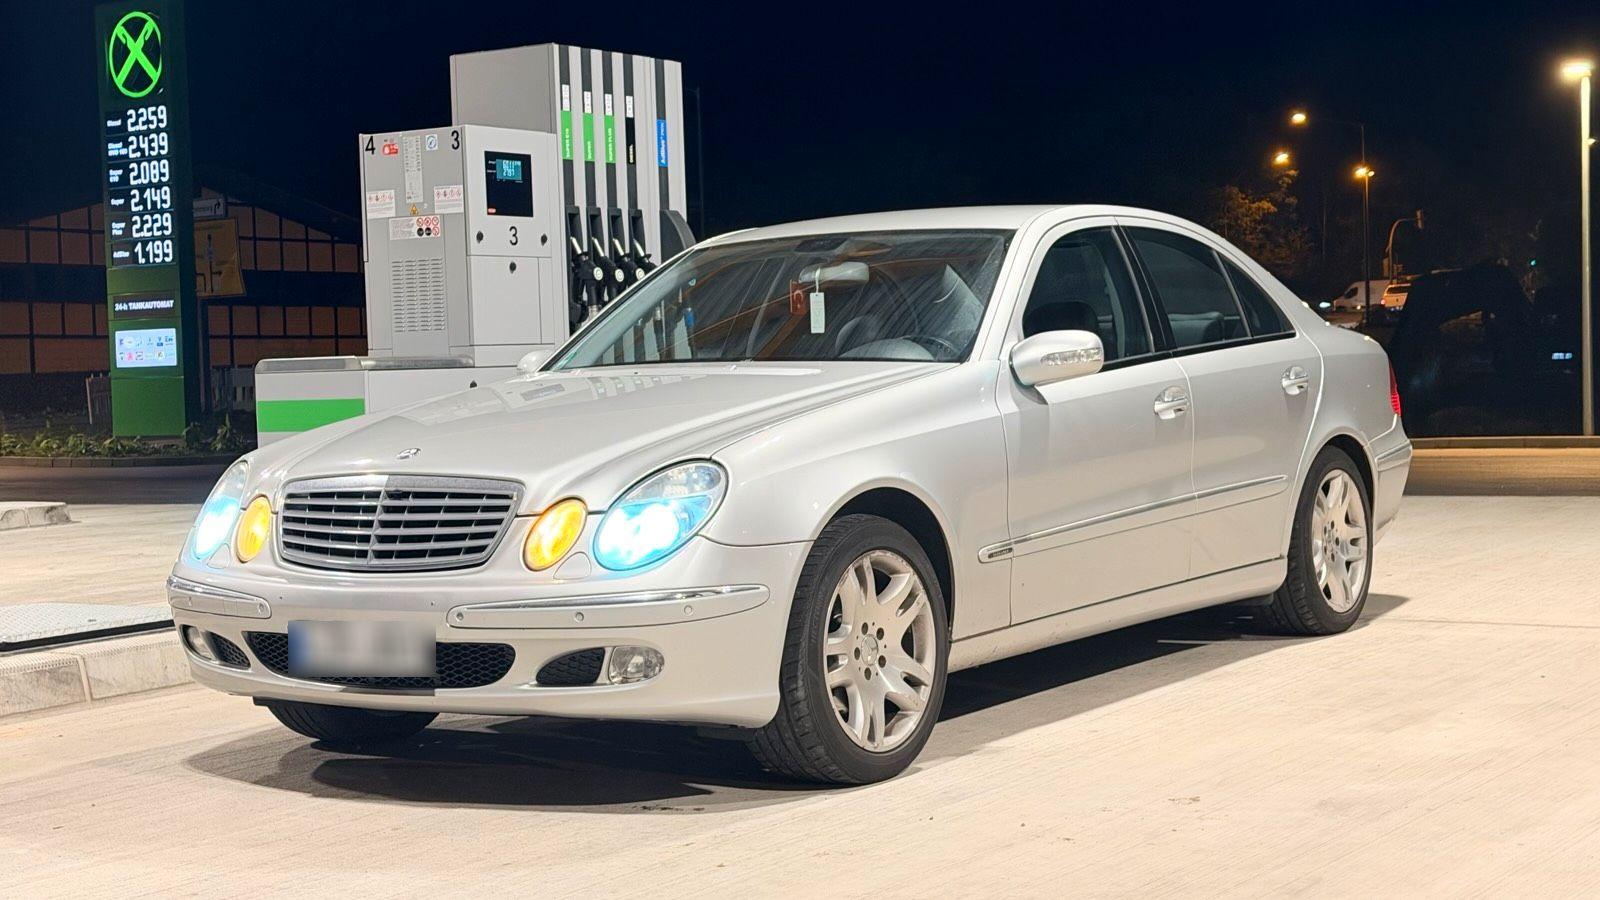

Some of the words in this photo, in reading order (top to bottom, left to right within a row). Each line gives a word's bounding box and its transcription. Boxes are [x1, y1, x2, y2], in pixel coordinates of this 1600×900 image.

[126, 105, 167, 132] 2.259
[128, 132, 169, 159] 2.439
[365, 135, 376, 155] 4
[451, 130, 460, 150] 3
[129, 159, 170, 186] 2.089
[130, 186, 171, 212] 2.149
[131, 212, 172, 238] 2.229
[509, 226, 518, 246] 3
[134, 239, 173, 264] 1.199
[128, 299, 174, 311] TANKAUTOMAT
